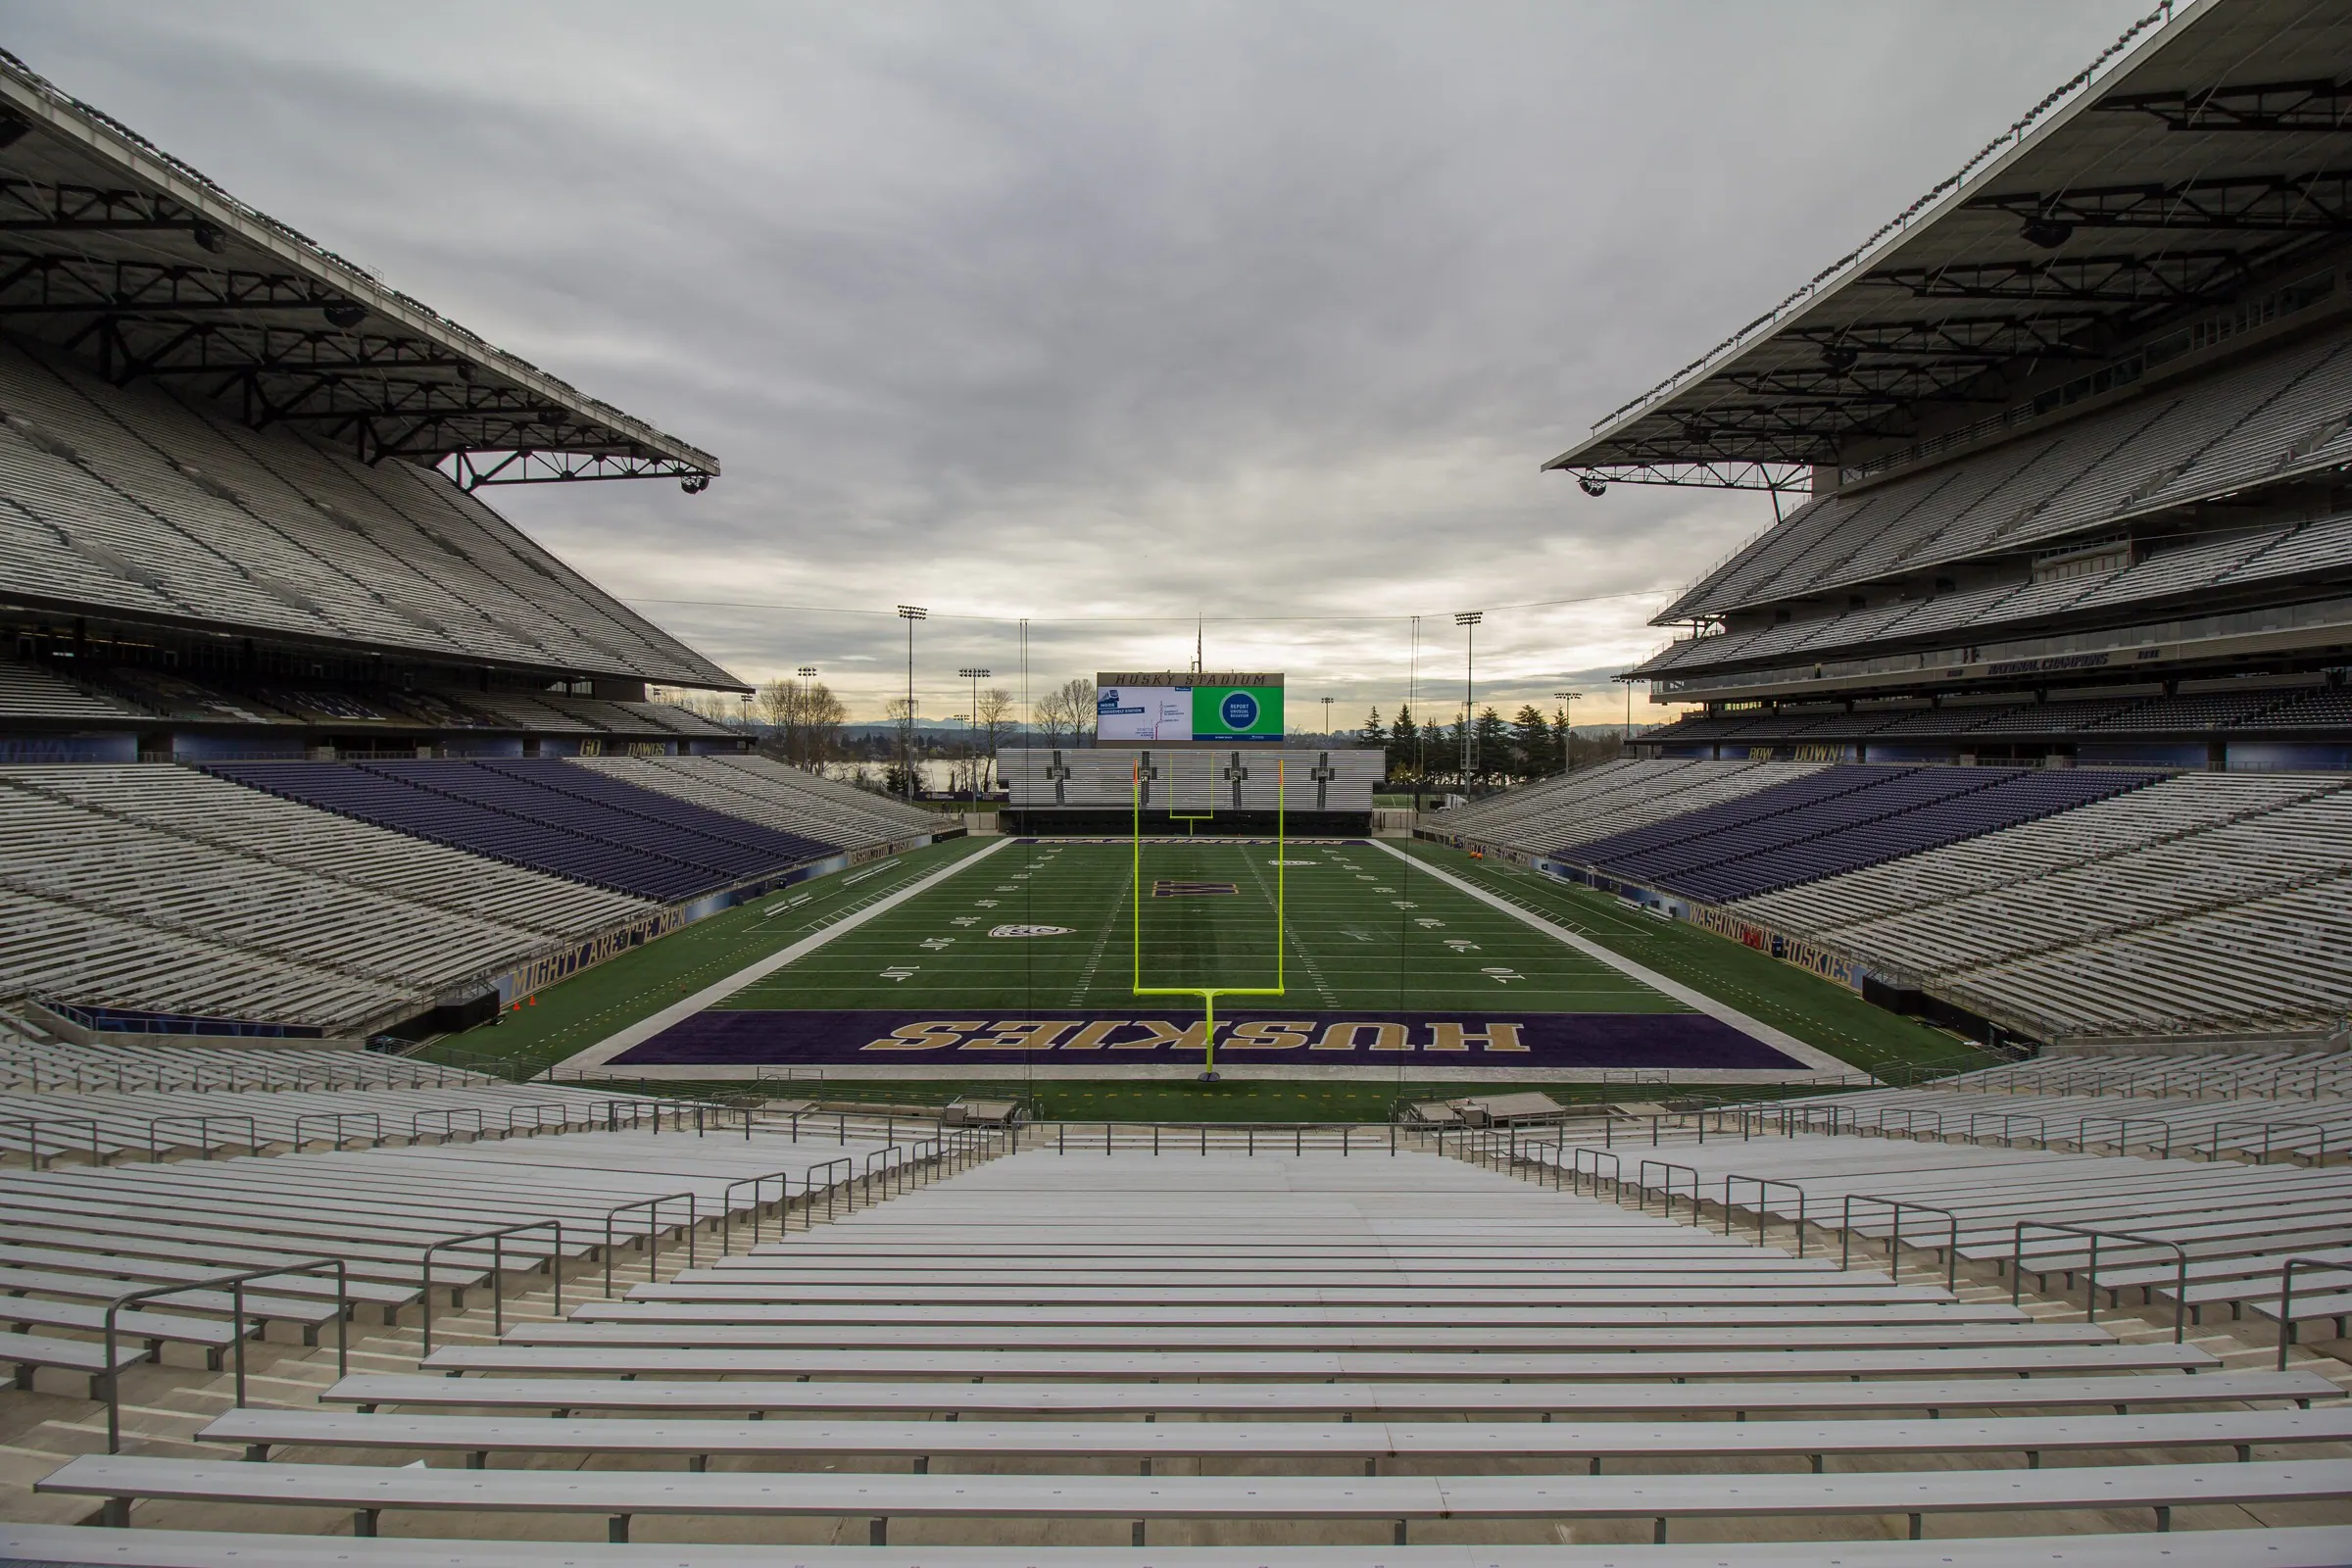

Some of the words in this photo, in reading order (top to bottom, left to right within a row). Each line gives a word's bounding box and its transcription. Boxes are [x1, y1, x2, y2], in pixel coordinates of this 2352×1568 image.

[1115, 674, 1175, 685] HUSKY
[1185, 674, 1266, 685] STADIUM
[579, 738, 602, 758] GO
[627, 743, 666, 757] DAWGS
[1748, 748, 1774, 761] BOW
[1793, 744, 1845, 761] DOWN!
[511, 946, 585, 1000] MIGHTY
[588, 933, 621, 964] ARE
[658, 906, 686, 935] MEN
[858, 1020, 1531, 1053] HUSKIES
